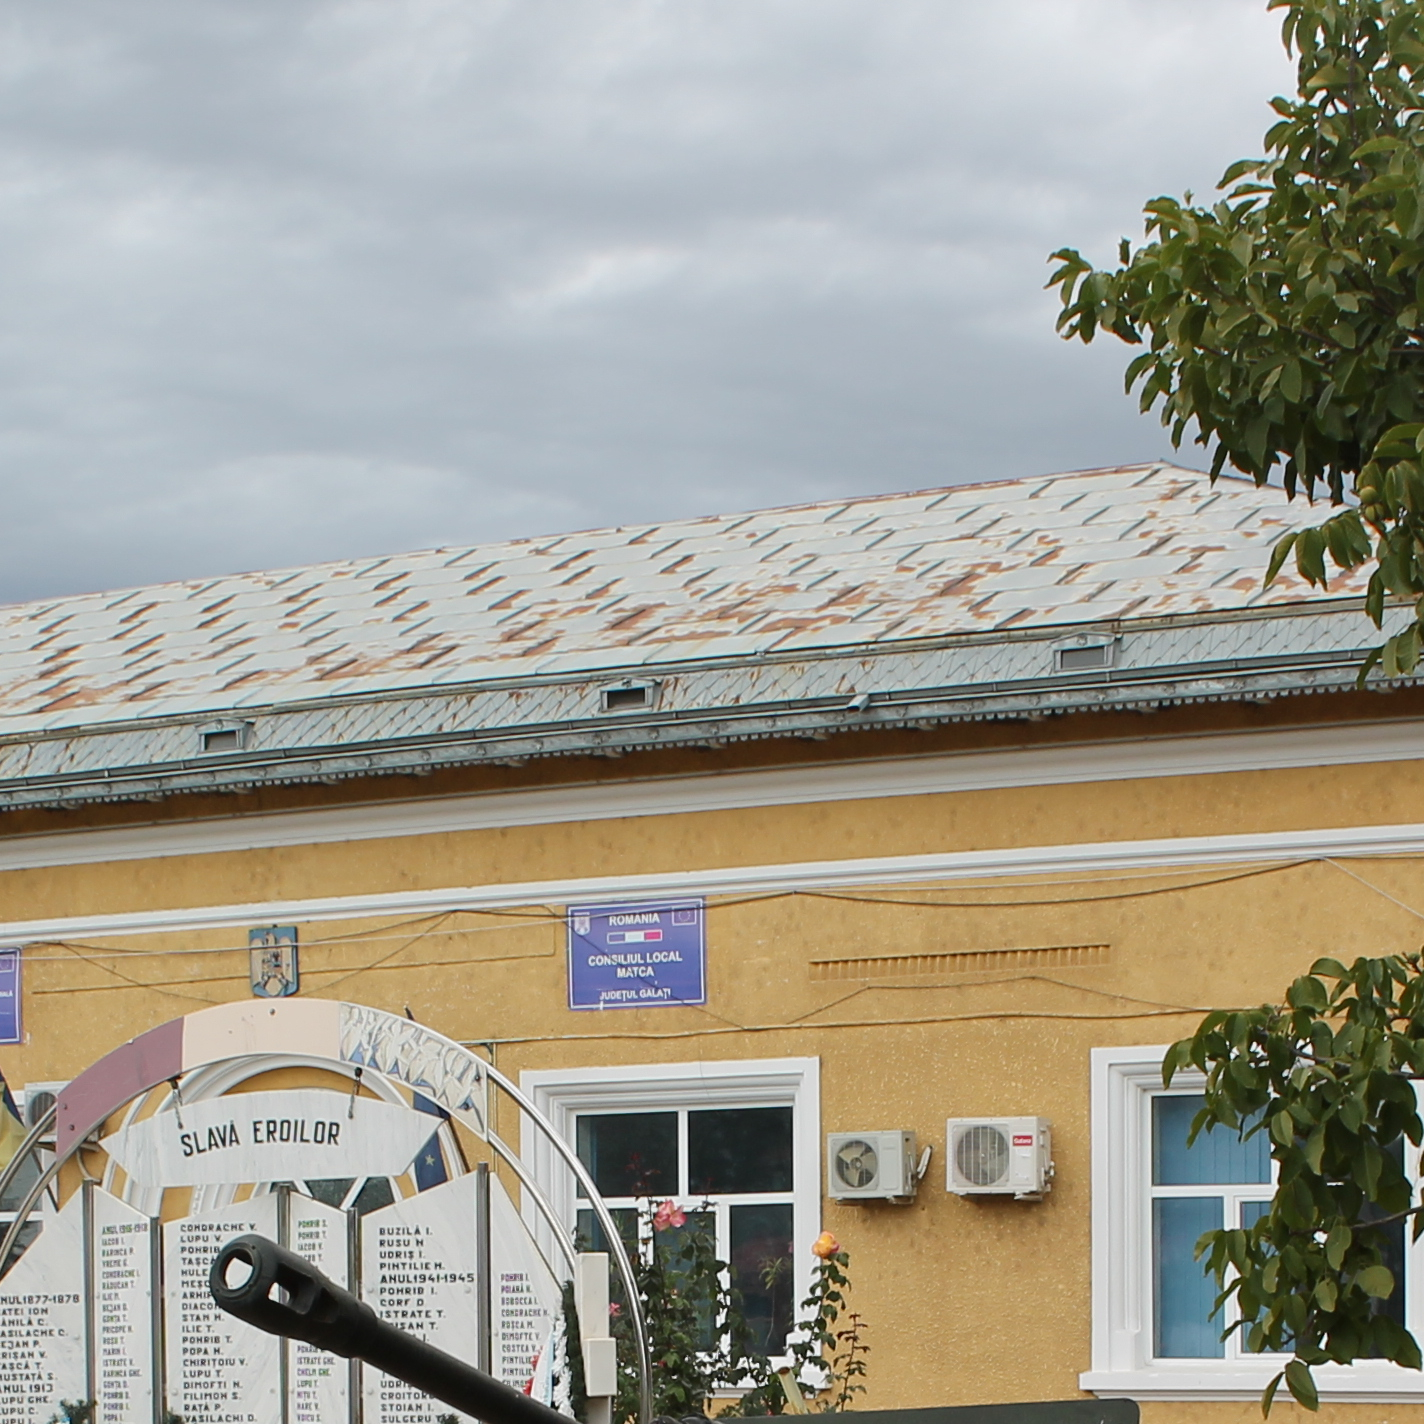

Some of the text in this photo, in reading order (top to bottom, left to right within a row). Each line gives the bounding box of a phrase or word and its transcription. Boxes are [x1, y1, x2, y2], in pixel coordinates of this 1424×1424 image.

[588, 951, 682, 966] CONSILIUL LOCAL
[617, 966, 654, 978] MATCA
[180, 1119, 340, 1157] SLAVĂ EROILOR
[181, 1223, 245, 1232] CONDRACHE
[181, 1235, 209, 1243] LUPU
[379, 1239, 410, 1248] RUSU
[379, 1262, 431, 1271] PINTILIE
[380, 1286, 424, 1295] POHRIB
[28, 1307, 48, 1315] ION
[380, 1310, 431, 1319] ISTRATE
[182, 1325, 202, 1333] ILIE
[182, 1336, 220, 1344] POHRIB
[182, 1347, 209, 1356] POPA
[183, 1370, 211, 1378] LUPU
[183, 1381, 227, 1389] DIMOFTI
[27, 1396, 52, 1404] GHE.
[183, 1392, 228, 1401] FILIMON
[381, 1403, 422, 1412] STOIAN
[184, 1414, 243, 1423] VASILACHI
